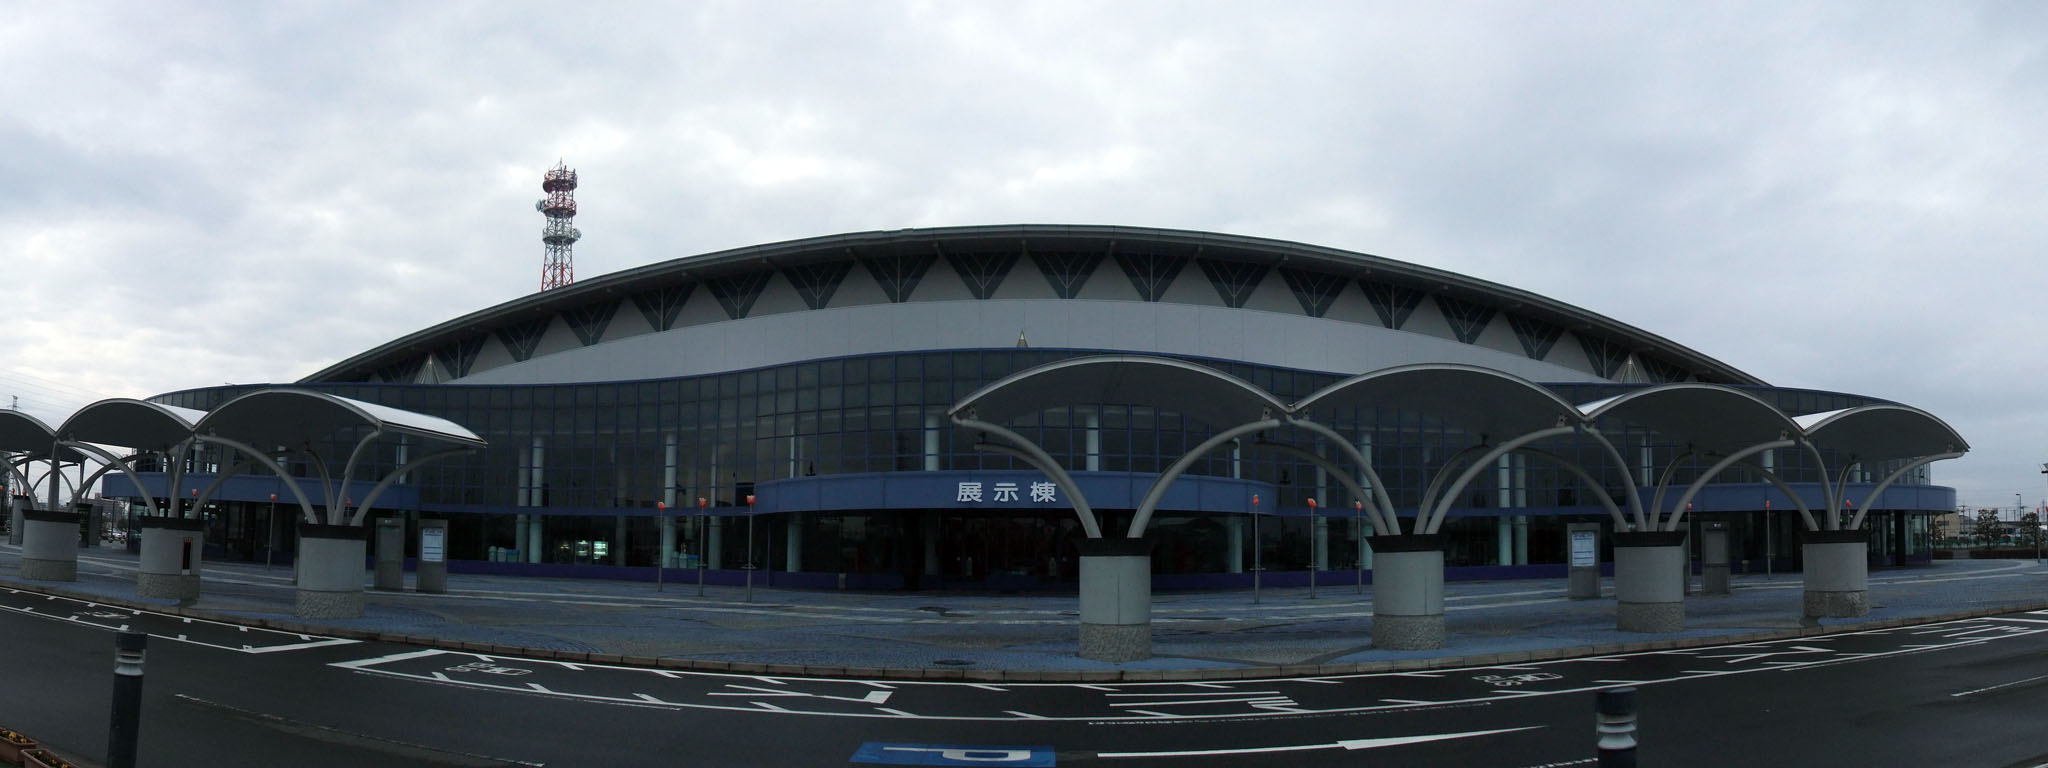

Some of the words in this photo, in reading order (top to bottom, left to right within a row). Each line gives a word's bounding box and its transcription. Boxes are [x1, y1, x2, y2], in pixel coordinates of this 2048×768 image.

[957, 482, 1056, 502] 展示棟
[883, 746, 1031, 761] P
